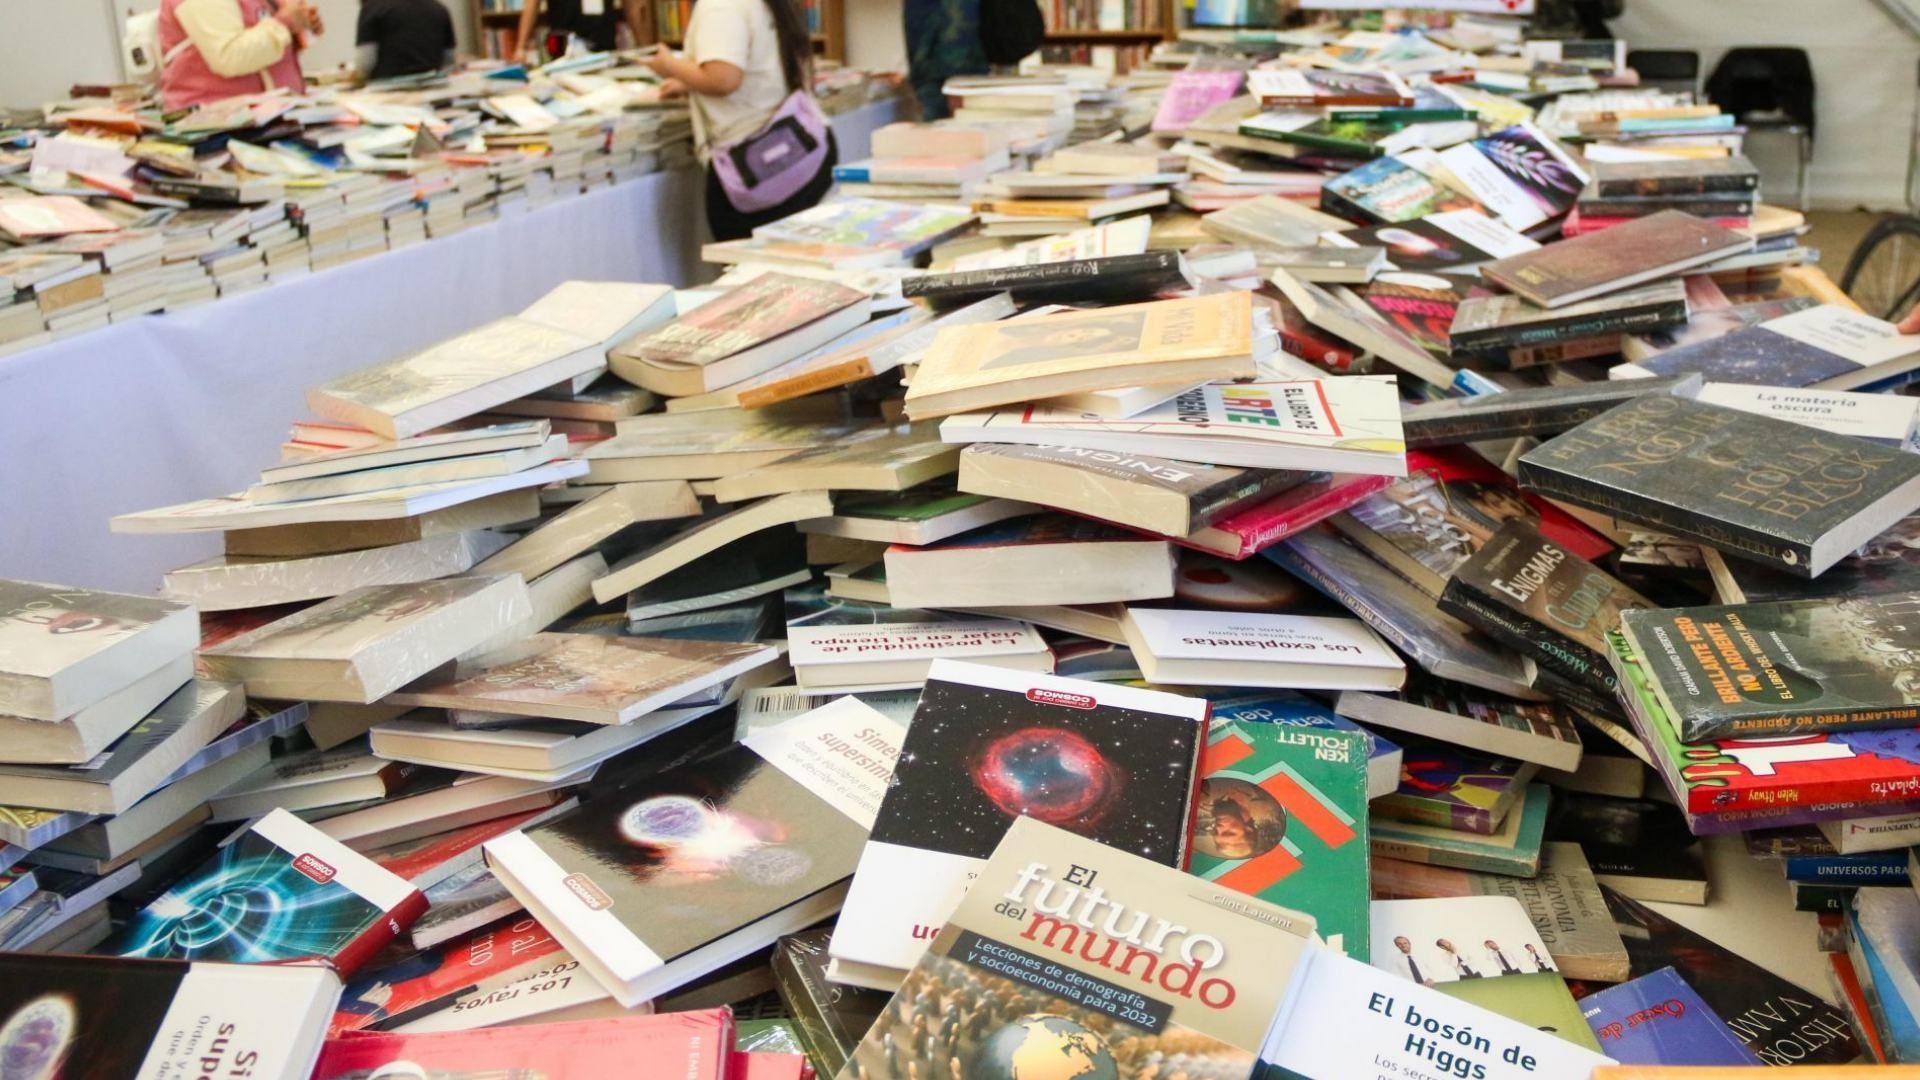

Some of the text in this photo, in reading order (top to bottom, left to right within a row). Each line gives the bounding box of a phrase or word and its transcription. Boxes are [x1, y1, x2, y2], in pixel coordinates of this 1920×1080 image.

[1174, 387, 1211, 423] ODERNO
[1221, 387, 1281, 426] ARTE
[1756, 392, 1778, 401] La
[1771, 403, 1834, 414] oscura
[1717, 436, 1846, 507] HOLLY
[1759, 449, 1895, 521] BLACK
[1490, 544, 1566, 602] ENIGMAS
[810, 631, 1024, 647] viajar en el tiempo
[822, 638, 1017, 654] La posibilidad de
[1182, 636, 1364, 654] Los exoplanetas
[1674, 616, 1743, 704] BRILLANTE PERO
[1702, 622, 1763, 693] NO ARDIENTE
[1765, 669, 1788, 690] LIBRO
[1034, 689, 1090, 703] COSMOS
[1779, 689, 1794, 700] EL
[1796, 715, 1813, 727] NO
[1818, 712, 1848, 724] PERO
[1852, 708, 1918, 723] BRILLANTE
[1277, 730, 1350, 751] FOLLETT
[1315, 749, 1350, 763] KEN
[1748, 788, 1799, 803] Helen Otway
[302, 855, 333, 877] COSMOS
[1063, 864, 1099, 890] El
[1817, 865, 1878, 876] UNIVERSOS
[994, 901, 1027, 921] del
[1212, 893, 1293, 929] Clint Laurent
[1520, 879, 1558, 946] PITALISMO
[1827, 899, 1840, 909] EL
[1003, 861, 1225, 970] futuro
[1020, 911, 1237, 1011] mundo
[975, 938, 1147, 1011] Lecciones de demografía
[452, 976, 573, 1014] Los rayos
[967, 948, 1158, 1029] y socioeconomía para 2032
[184, 1015, 211, 1056] Orden
[1367, 992, 1538, 1072] El bosón de
[1374, 1053, 1398, 1072] Los
[1403, 1033, 1488, 1080] Higgs
